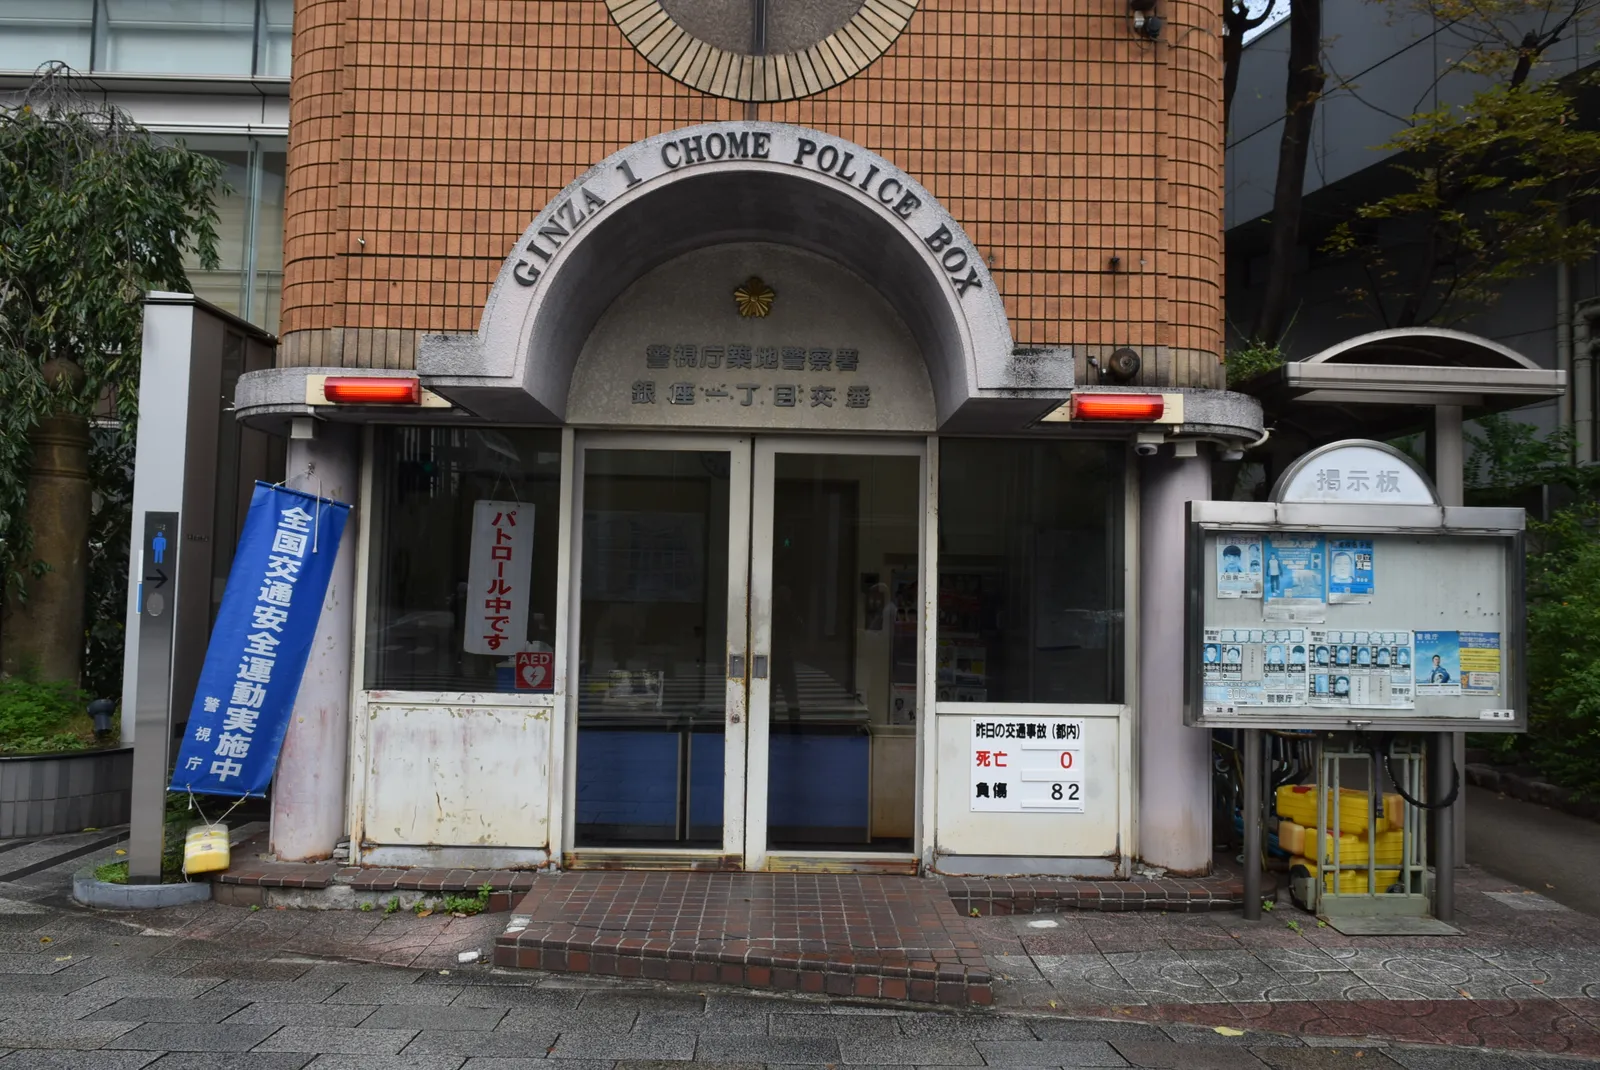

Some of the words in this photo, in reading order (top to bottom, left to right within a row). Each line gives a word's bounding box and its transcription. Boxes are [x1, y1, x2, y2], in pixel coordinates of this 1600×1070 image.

[513, 187, 606, 287] GINZA
[616, 159, 643, 188] 1
[661, 131, 771, 168] CHOME
[794, 137, 922, 220] POLICE
[924, 223, 983, 298] BOX
[646, 344, 859, 371] 警視庁築地警察署
[631, 380, 871, 408] 銀座一丁目交番
[1316, 469, 1401, 493] 掲示板
[483, 510, 517, 650] パトロール中です
[209, 506, 313, 782] 全国交通安全運動実施中
[519, 653, 550, 665] AED
[185, 696, 220, 771] 警視庁
[976, 751, 1008, 767] 死亡
[1060, 751, 1073, 769] 0
[976, 782, 1008, 799] 負傷
[1051, 783, 1080, 801] 82
